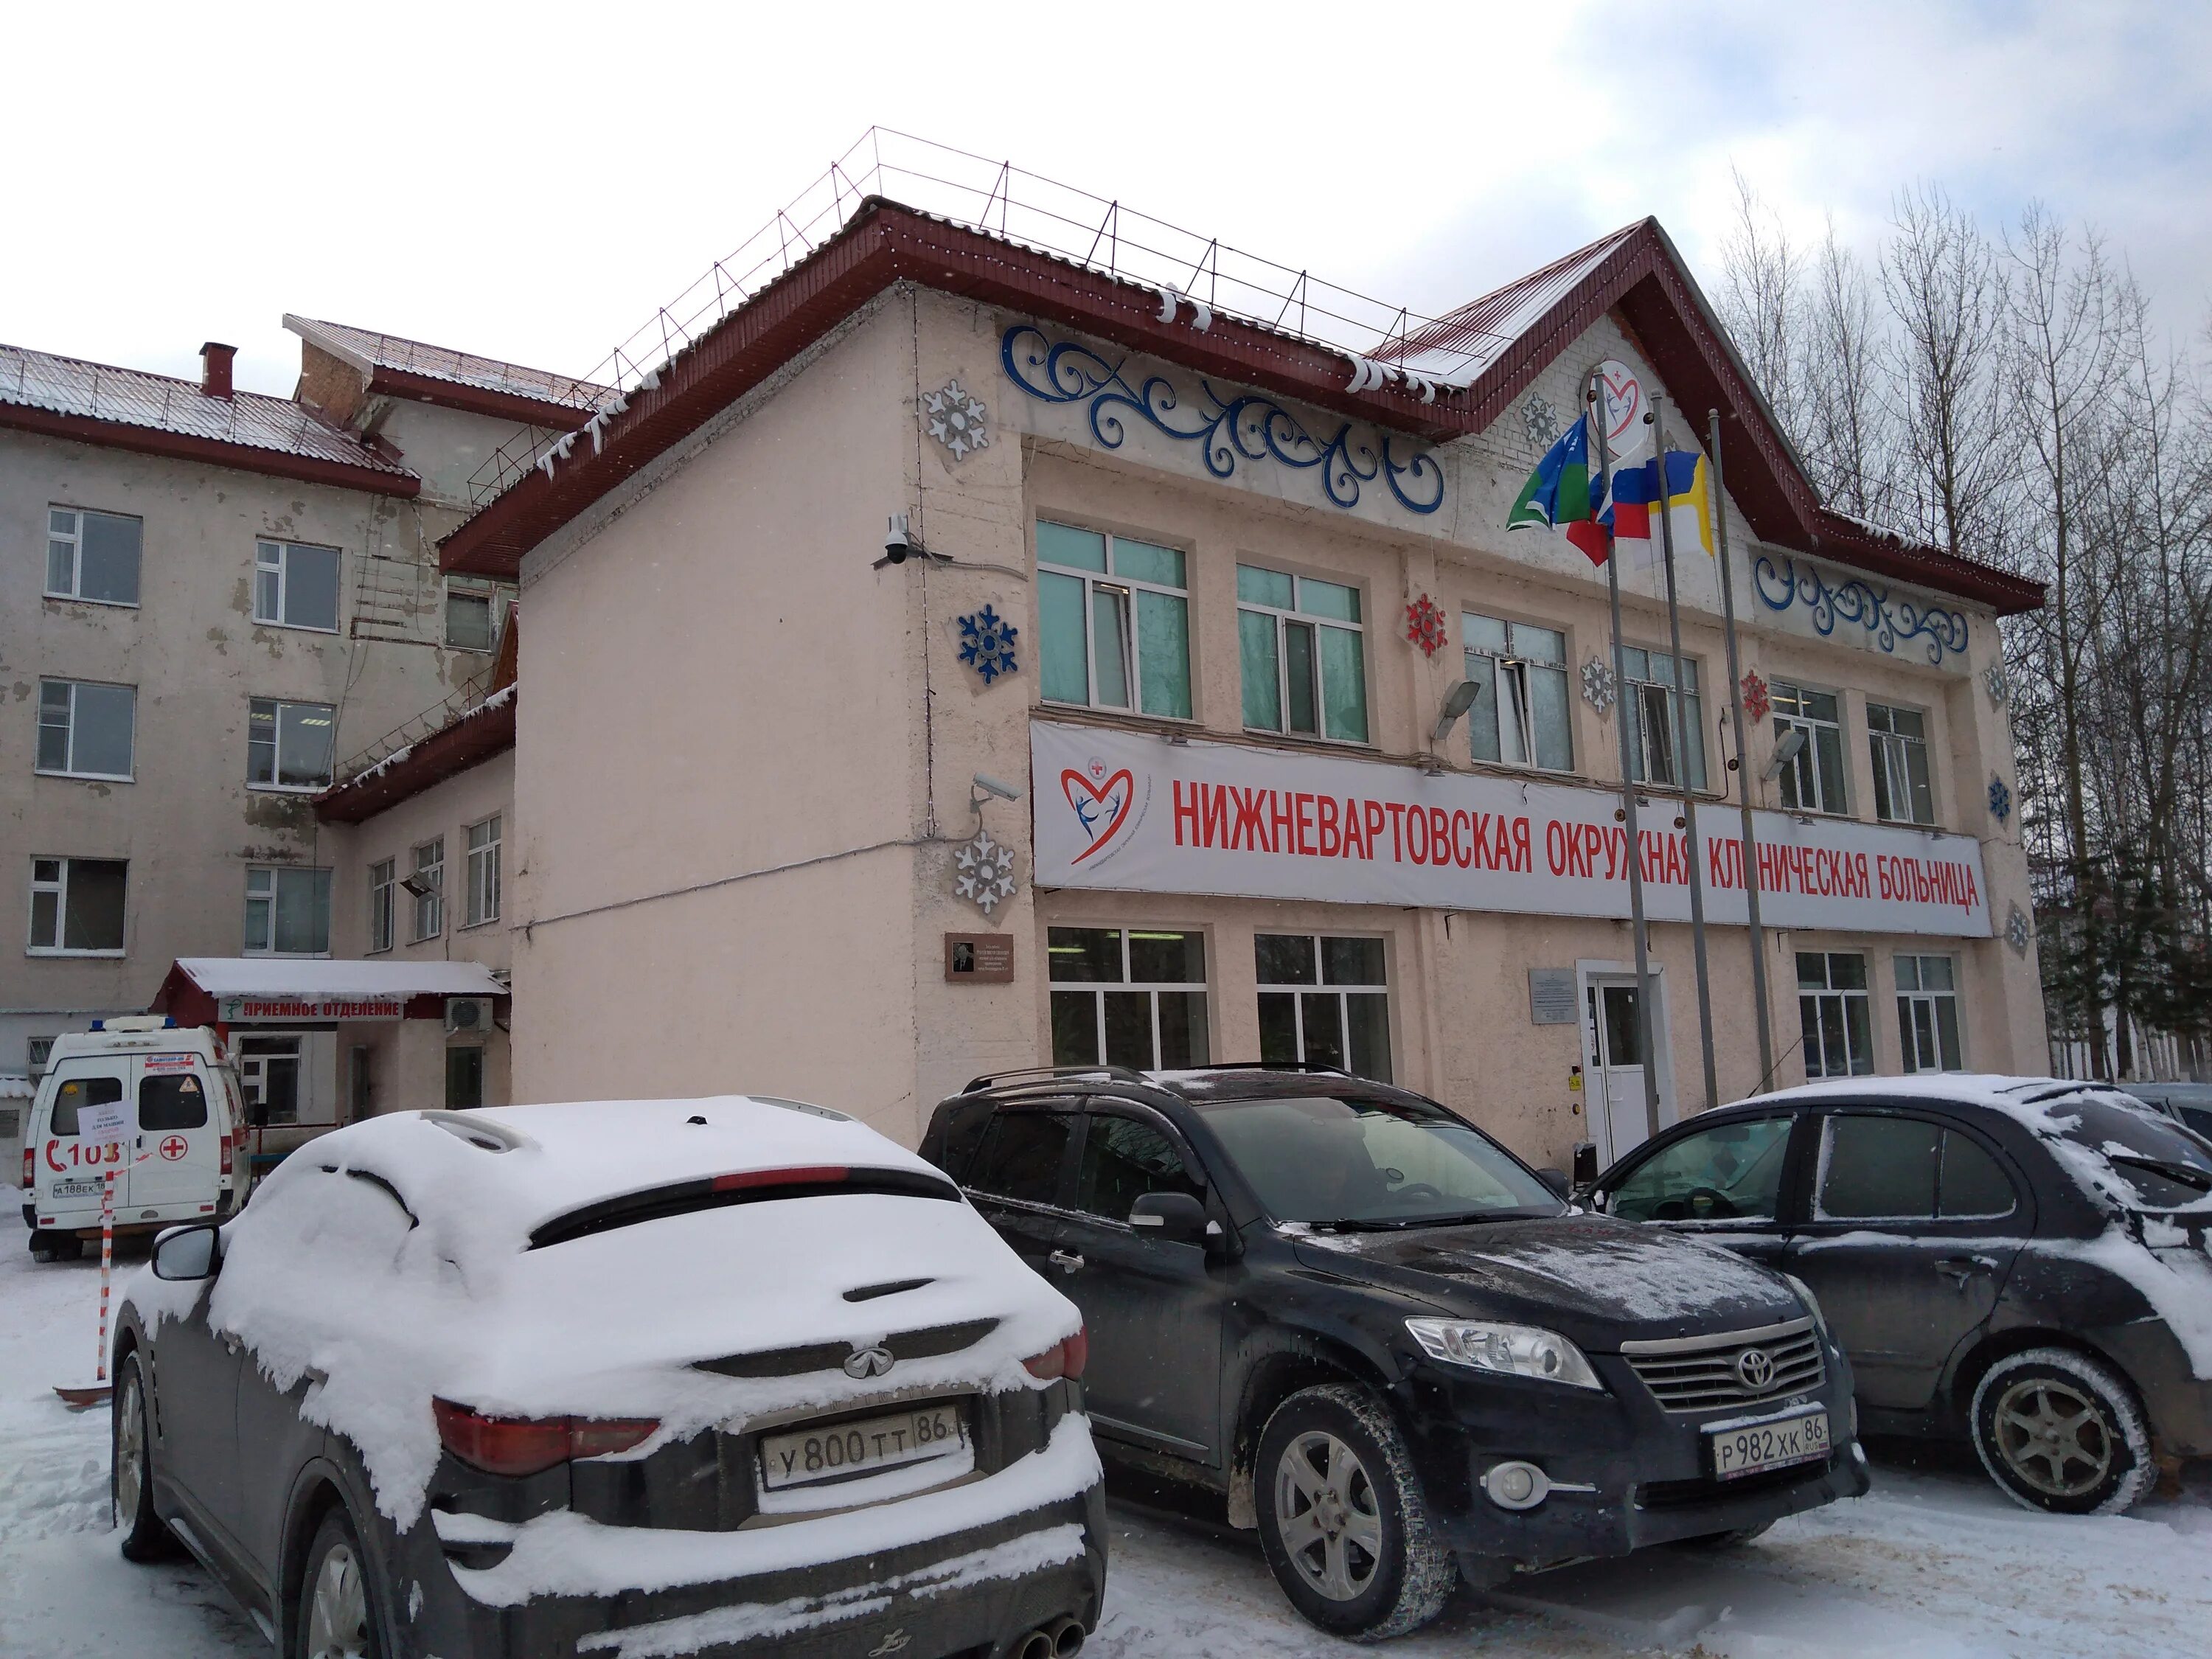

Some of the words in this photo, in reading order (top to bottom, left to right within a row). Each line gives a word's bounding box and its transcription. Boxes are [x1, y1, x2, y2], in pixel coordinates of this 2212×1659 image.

[1172, 779, 1532, 874] НИЖНЕВАРТОВСКАЯ
[1546, 819, 1690, 885] ОКРУЖНАЯ
[1876, 854, 1980, 916] БОЛЬНИЦА
[244, 1001, 318, 1017] ПРИЕМНОЕ
[323, 1001, 399, 1018] ОТДЕЛЕНИЕ
[67, 1142, 120, 1166] 103
[917, 1413, 947, 1443] 86
[1804, 1417, 1823, 1441] 86
